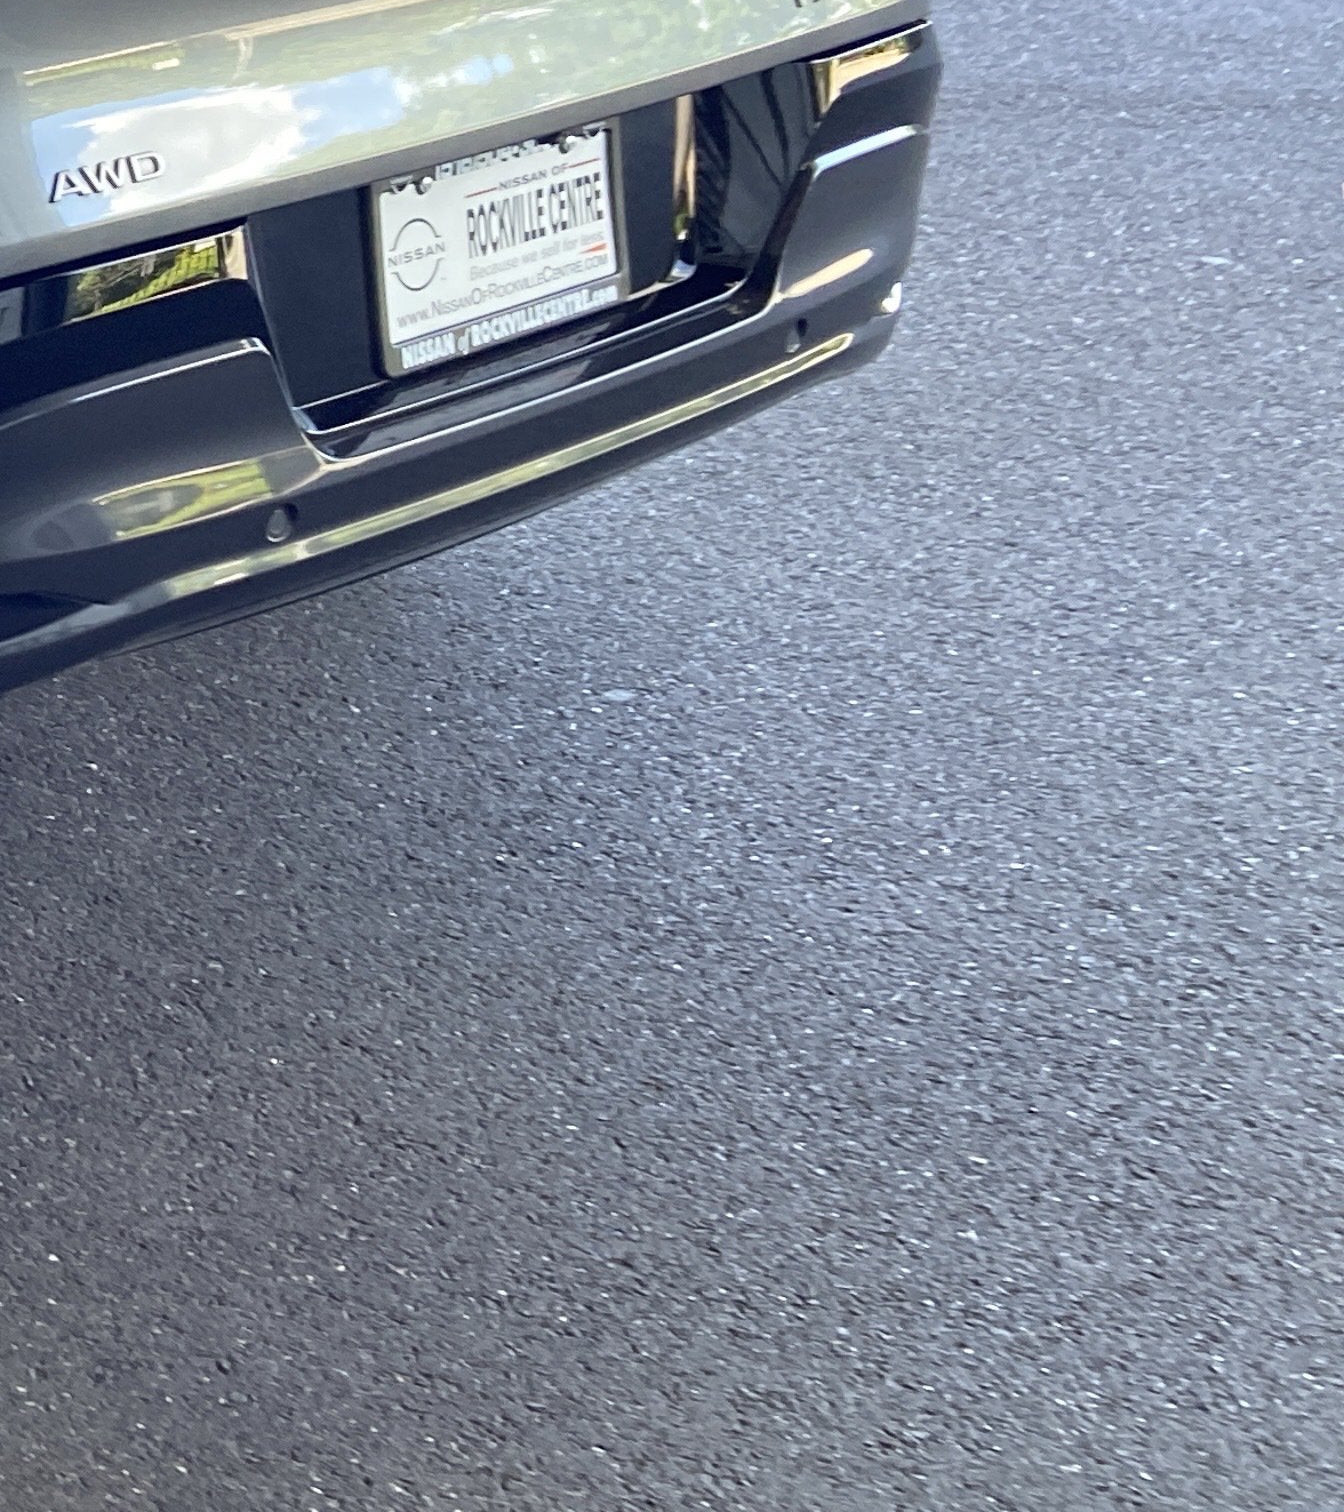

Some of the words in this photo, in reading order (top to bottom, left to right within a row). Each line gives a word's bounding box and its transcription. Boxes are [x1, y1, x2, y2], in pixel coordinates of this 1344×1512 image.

[48, 150, 166, 204] AWD
[498, 171, 548, 191] NISSAN
[551, 162, 570, 177] OF
[466, 188, 546, 259] ROCKVILLE
[547, 172, 604, 235] CENTRE
[387, 241, 447, 269] NISSAN
[400, 331, 456, 370] NISSAN
